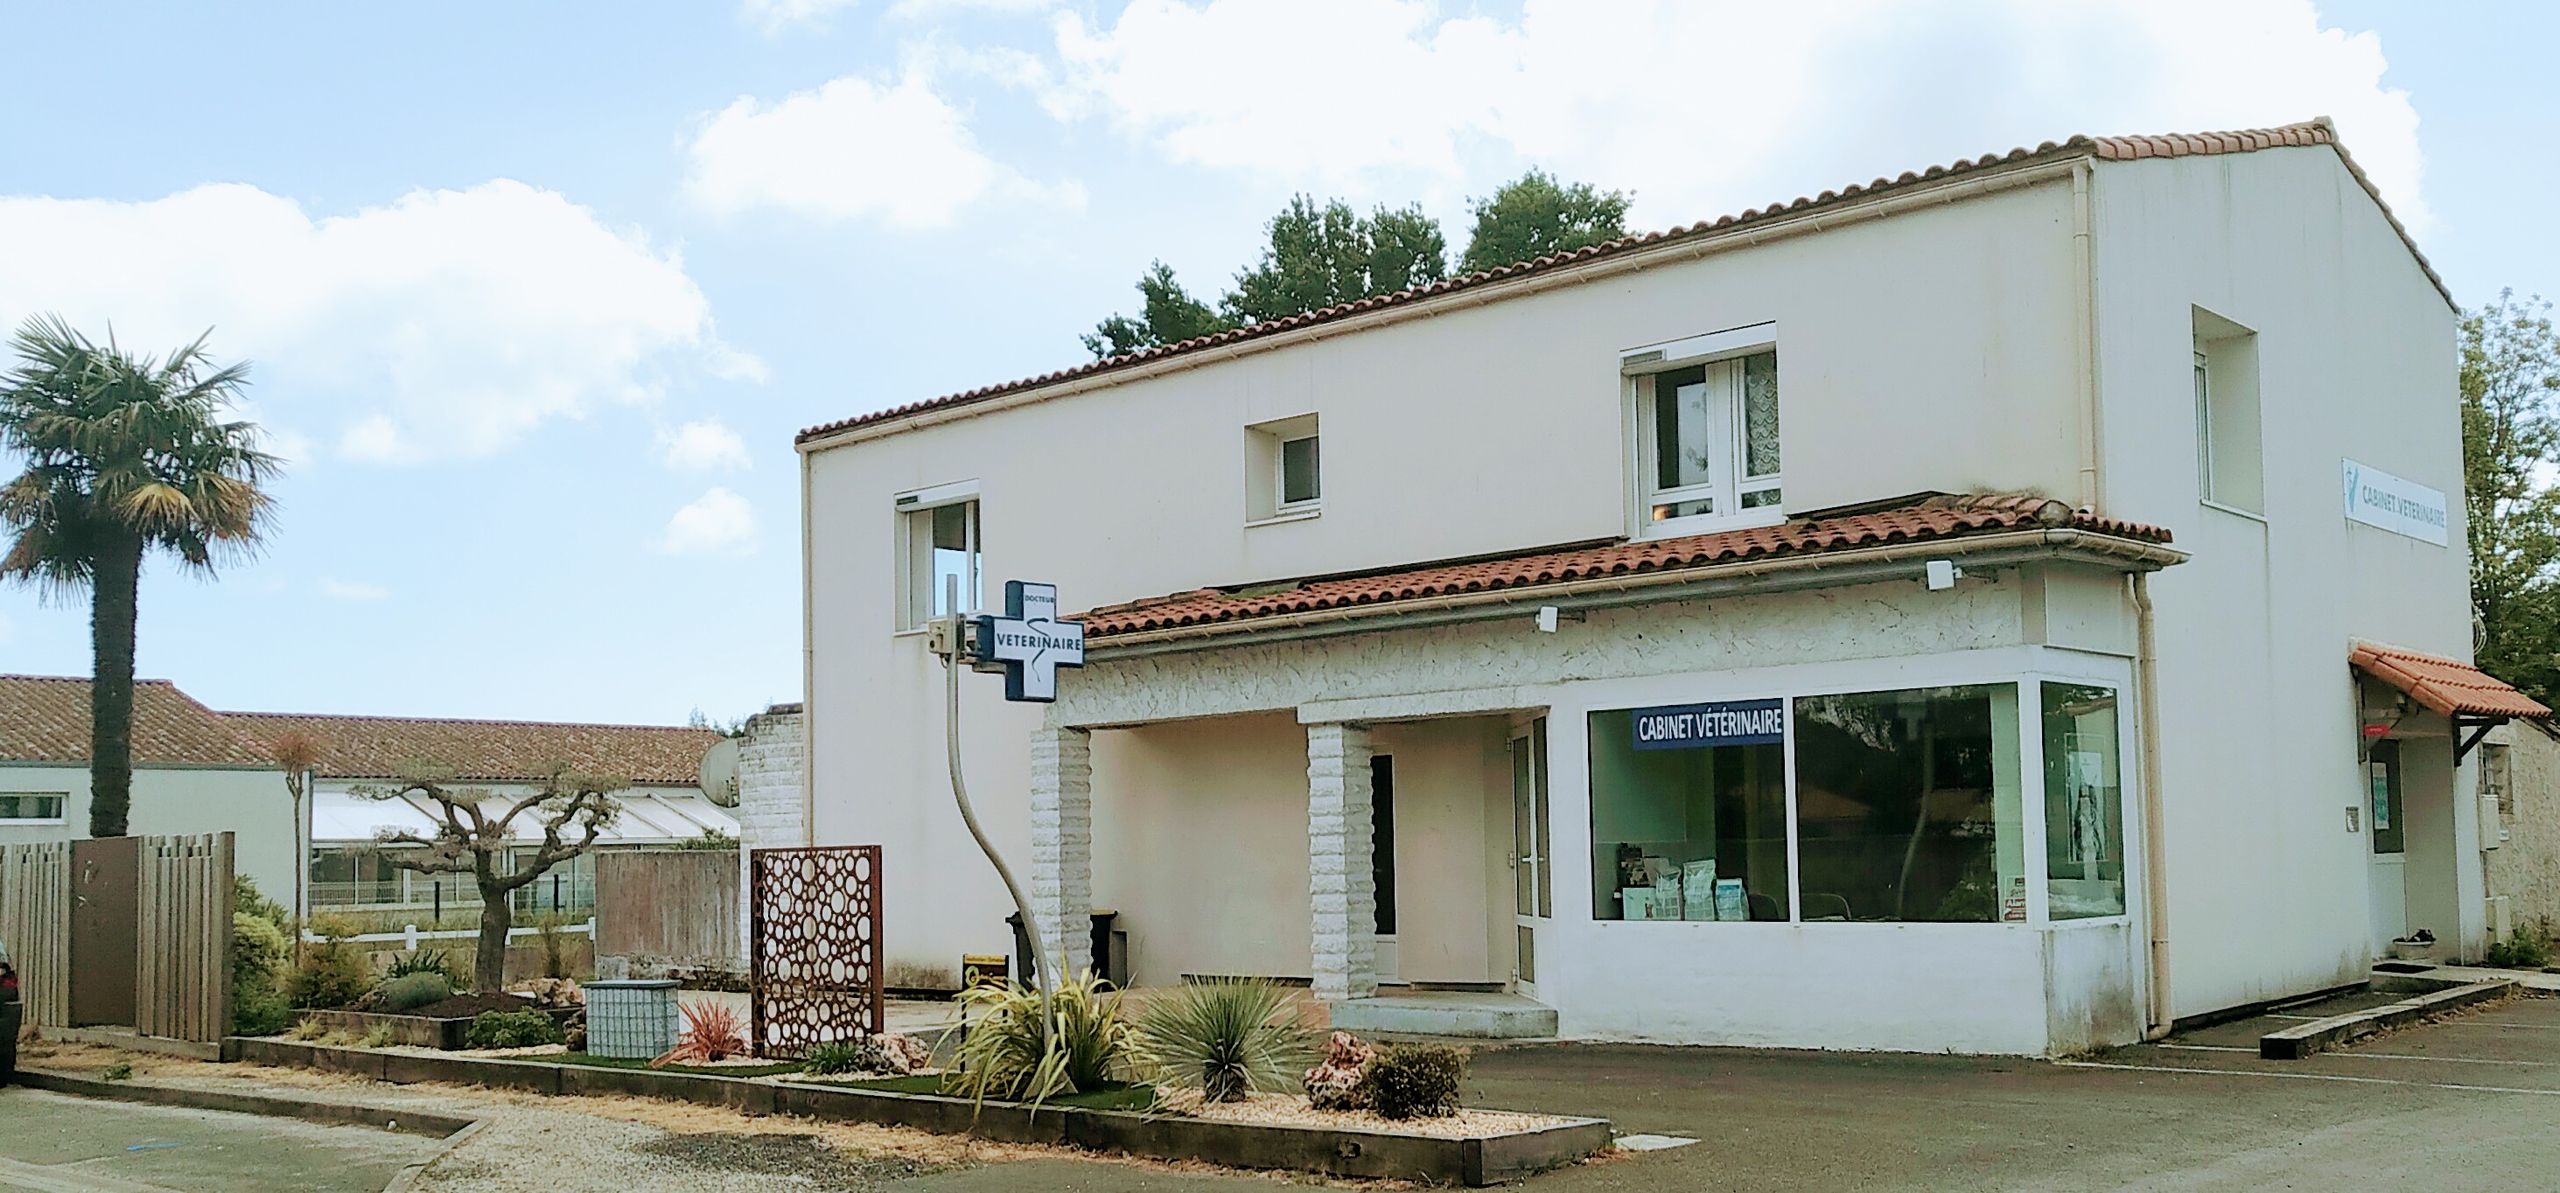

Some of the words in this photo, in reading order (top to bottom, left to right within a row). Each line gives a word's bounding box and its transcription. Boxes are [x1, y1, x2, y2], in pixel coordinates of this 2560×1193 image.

[2362, 485, 2396, 513] CABINET
[1024, 595, 1055, 603] DOCTEUR
[997, 633, 1081, 650] VETERINAIRE
[1639, 713, 1693, 741] CABINET
[1695, 707, 1782, 738] VÉTÉRINAIRE
